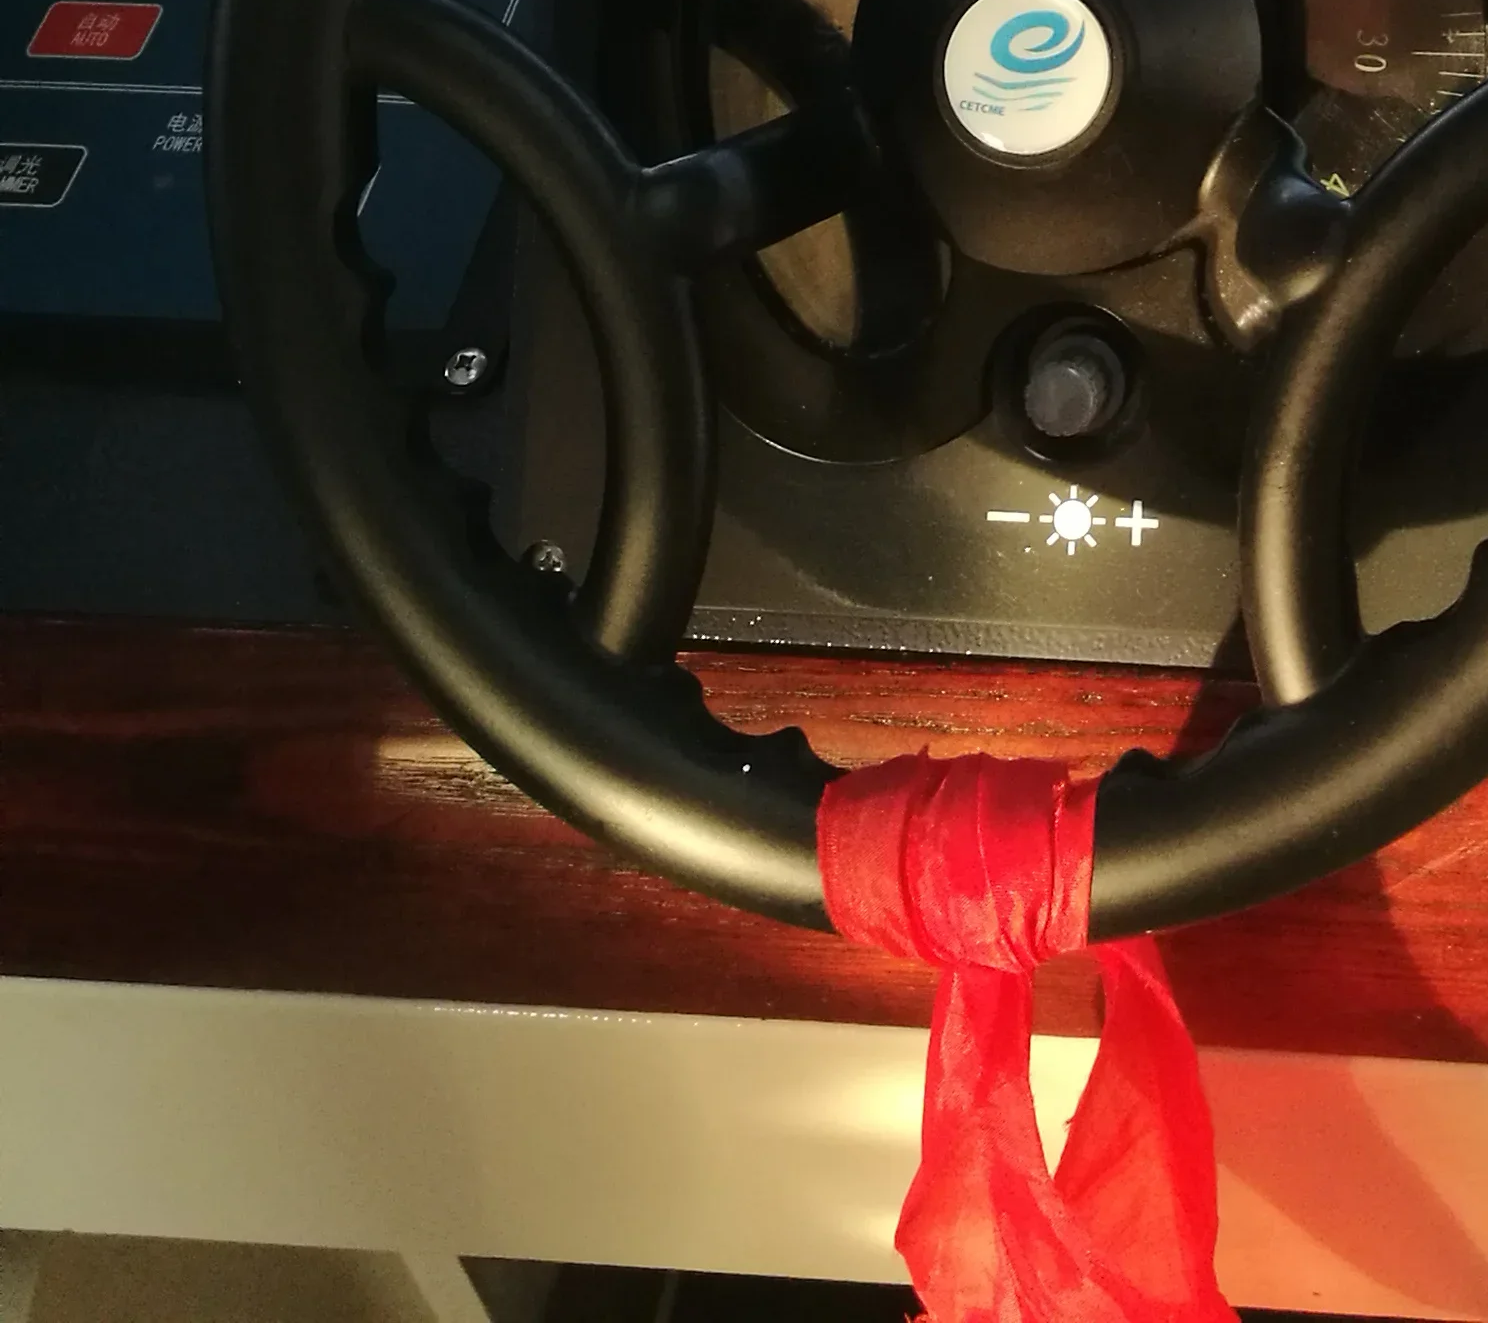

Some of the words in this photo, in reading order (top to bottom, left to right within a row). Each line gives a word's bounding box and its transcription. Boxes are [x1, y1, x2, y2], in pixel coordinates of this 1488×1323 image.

[1353, 29, 1391, 75] 30
[959, 99, 1006, 118] CETCME
[152, 135, 204, 153] POWER
